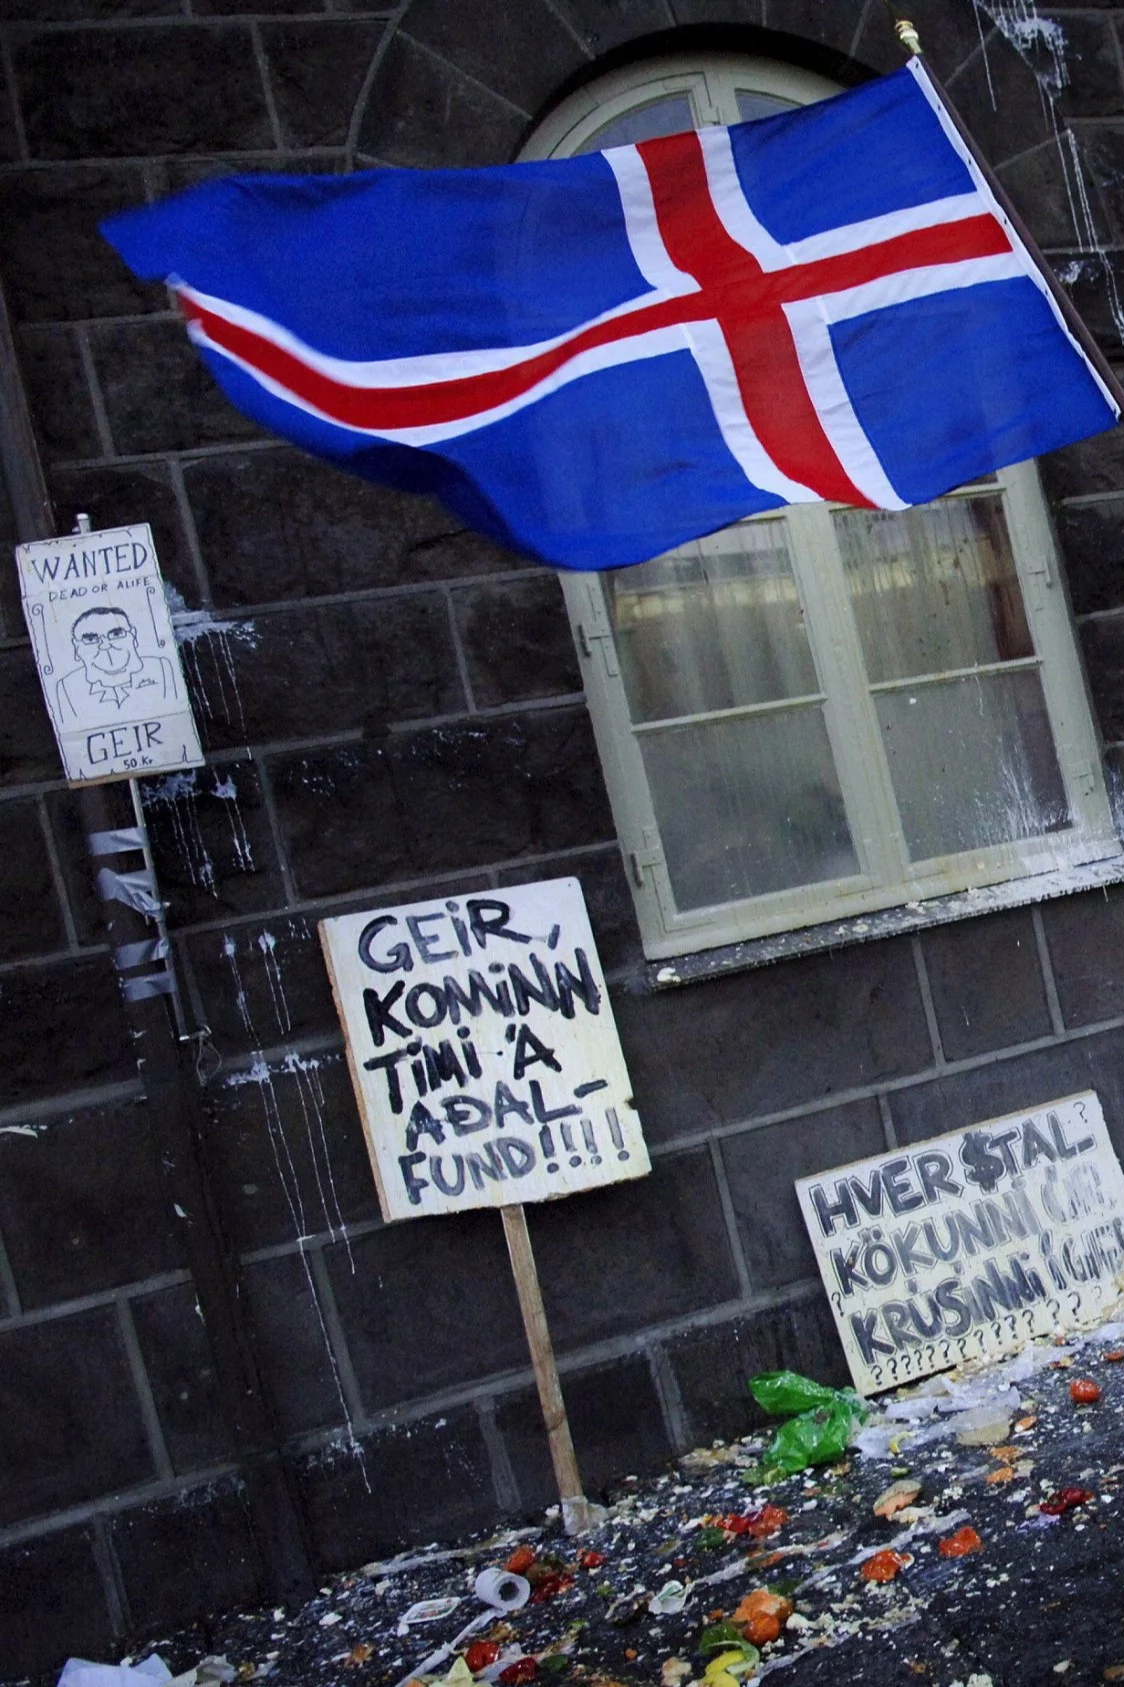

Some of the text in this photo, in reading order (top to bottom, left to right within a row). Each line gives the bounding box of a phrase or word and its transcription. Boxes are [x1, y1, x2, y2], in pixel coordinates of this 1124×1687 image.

[31, 542, 148, 584] WANTED
[48, 577, 150, 603] DEAD OR ALIFE
[86, 721, 163, 765] GEIR
[123, 758, 138, 769] 50
[809, 1149, 964, 1237] HVER
[829, 1176, 1044, 1299] KÖKUNNI
